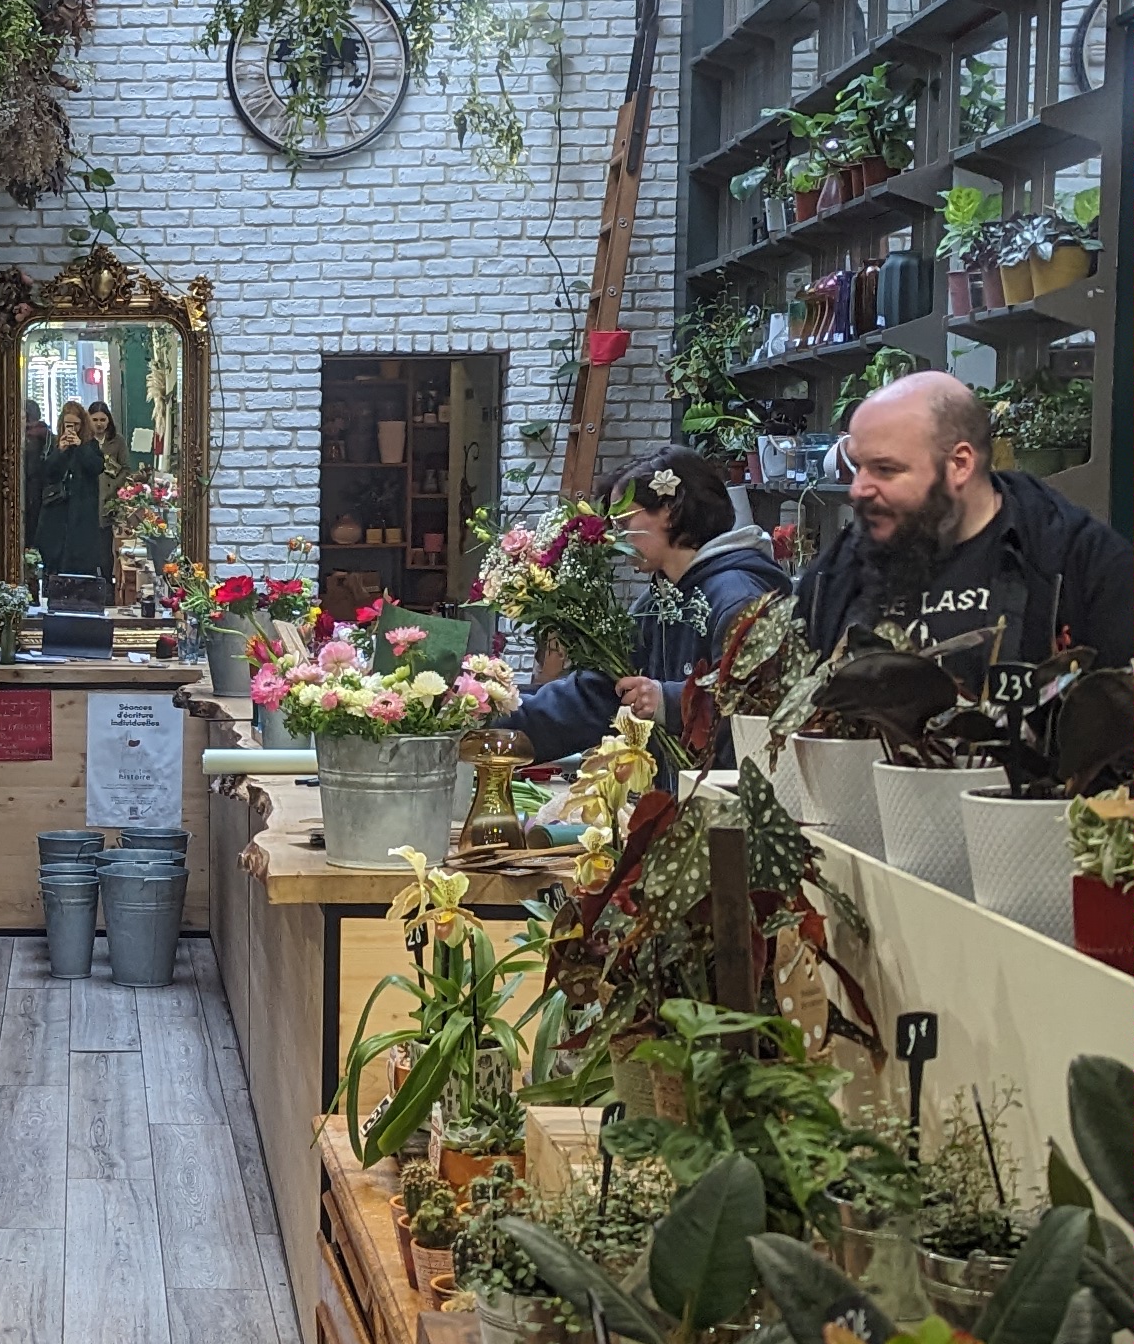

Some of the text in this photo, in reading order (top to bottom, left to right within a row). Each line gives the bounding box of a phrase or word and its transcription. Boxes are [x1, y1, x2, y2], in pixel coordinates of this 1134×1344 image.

[920, 587, 991, 615] LAST
[118, 703, 153, 711] Séances
[110, 719, 160, 727] individuelles
[118, 773, 151, 781] histoire
